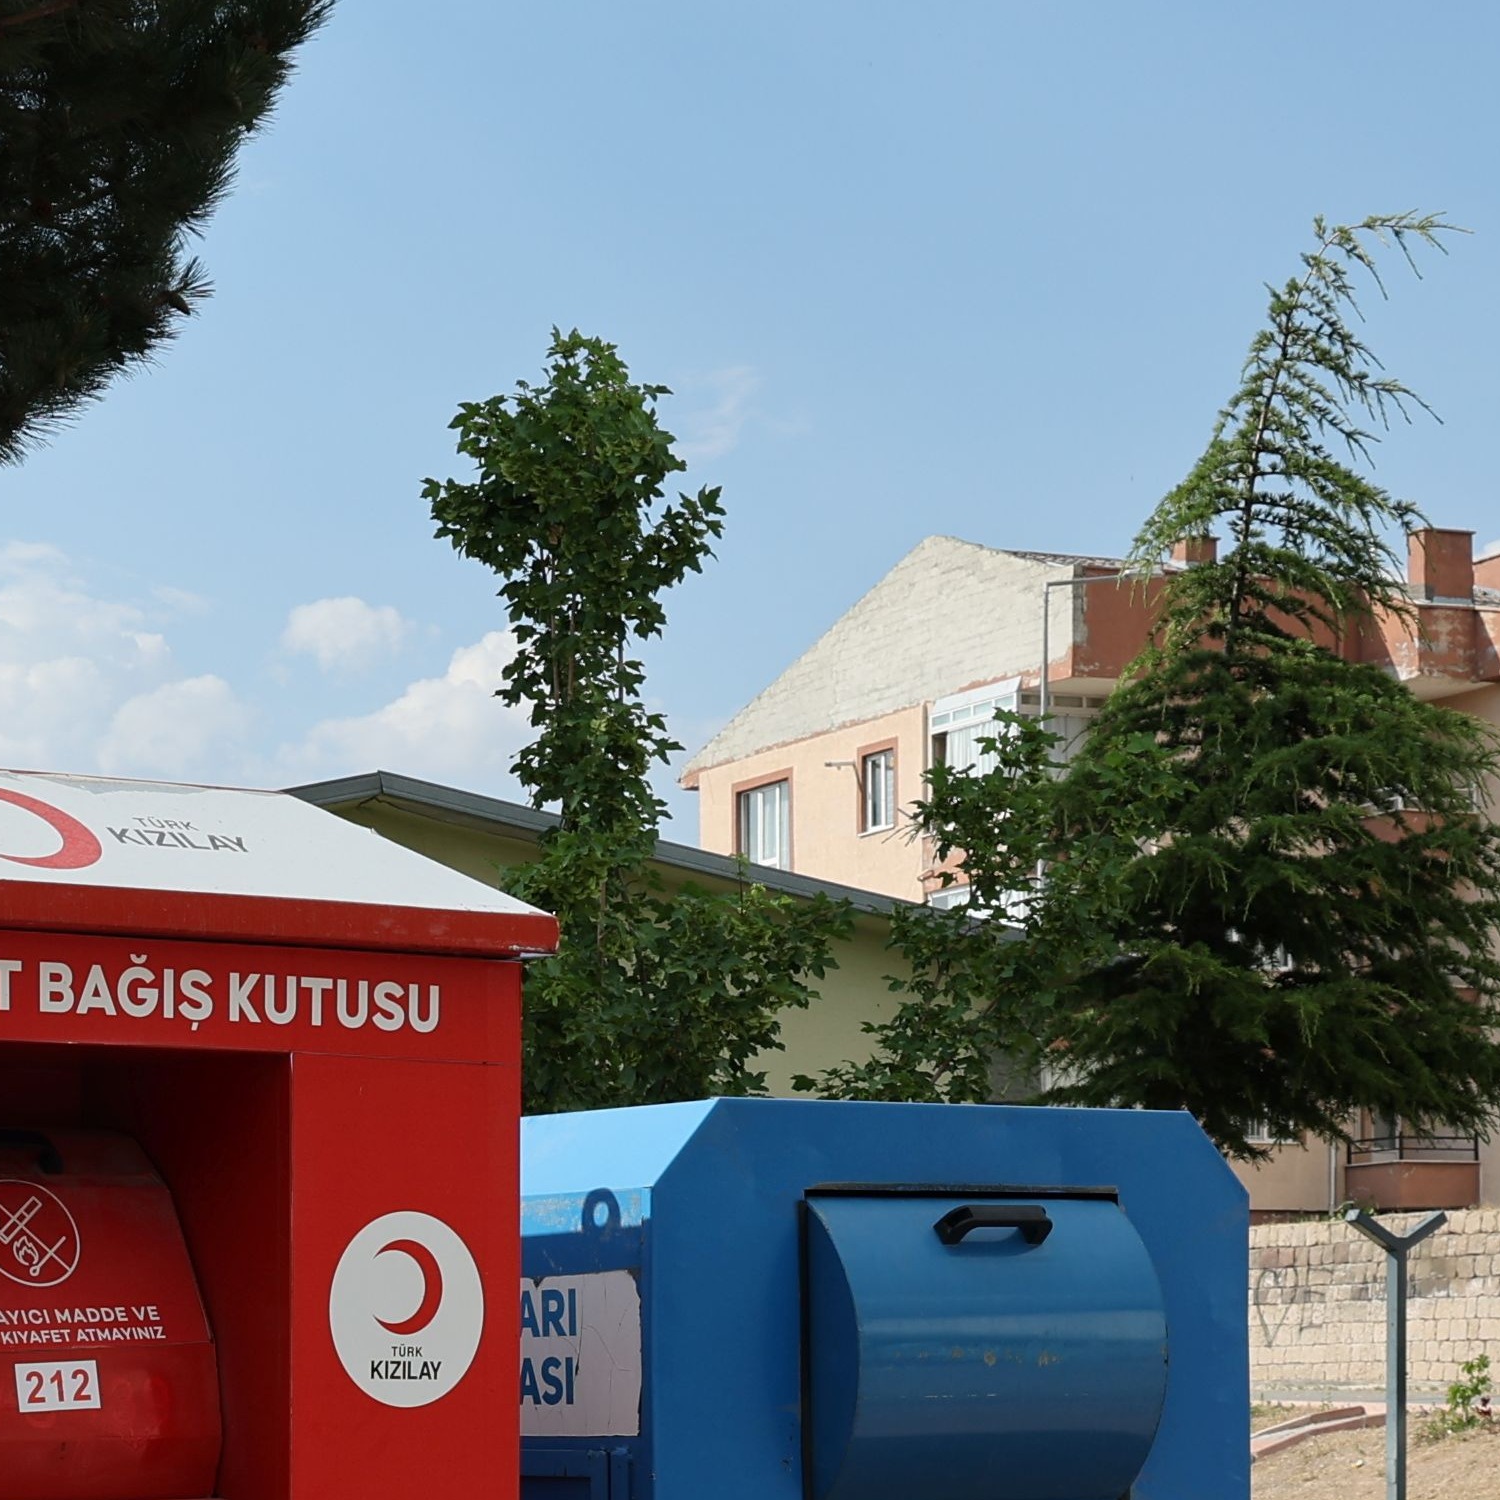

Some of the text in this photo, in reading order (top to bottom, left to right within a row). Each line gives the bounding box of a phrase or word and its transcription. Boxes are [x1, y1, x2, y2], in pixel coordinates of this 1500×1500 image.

[132, 816, 200, 831] TÜRK
[105, 826, 249, 853] KIZILAY
[38, 953, 213, 1031] BAĞIŞ
[229, 972, 440, 1033] KUTUSU
[54, 1306, 129, 1324] MADDE
[130, 1305, 161, 1321] VE
[520, 1288, 577, 1338] ARI
[0, 1329, 71, 1345] KIYAFET
[76, 1326, 166, 1342] ATMAYINIZ
[391, 1343, 423, 1357] TÜRK
[370, 1360, 442, 1380] KIZILAY
[520, 1356, 574, 1405] ASI
[25, 1368, 92, 1404] 212
